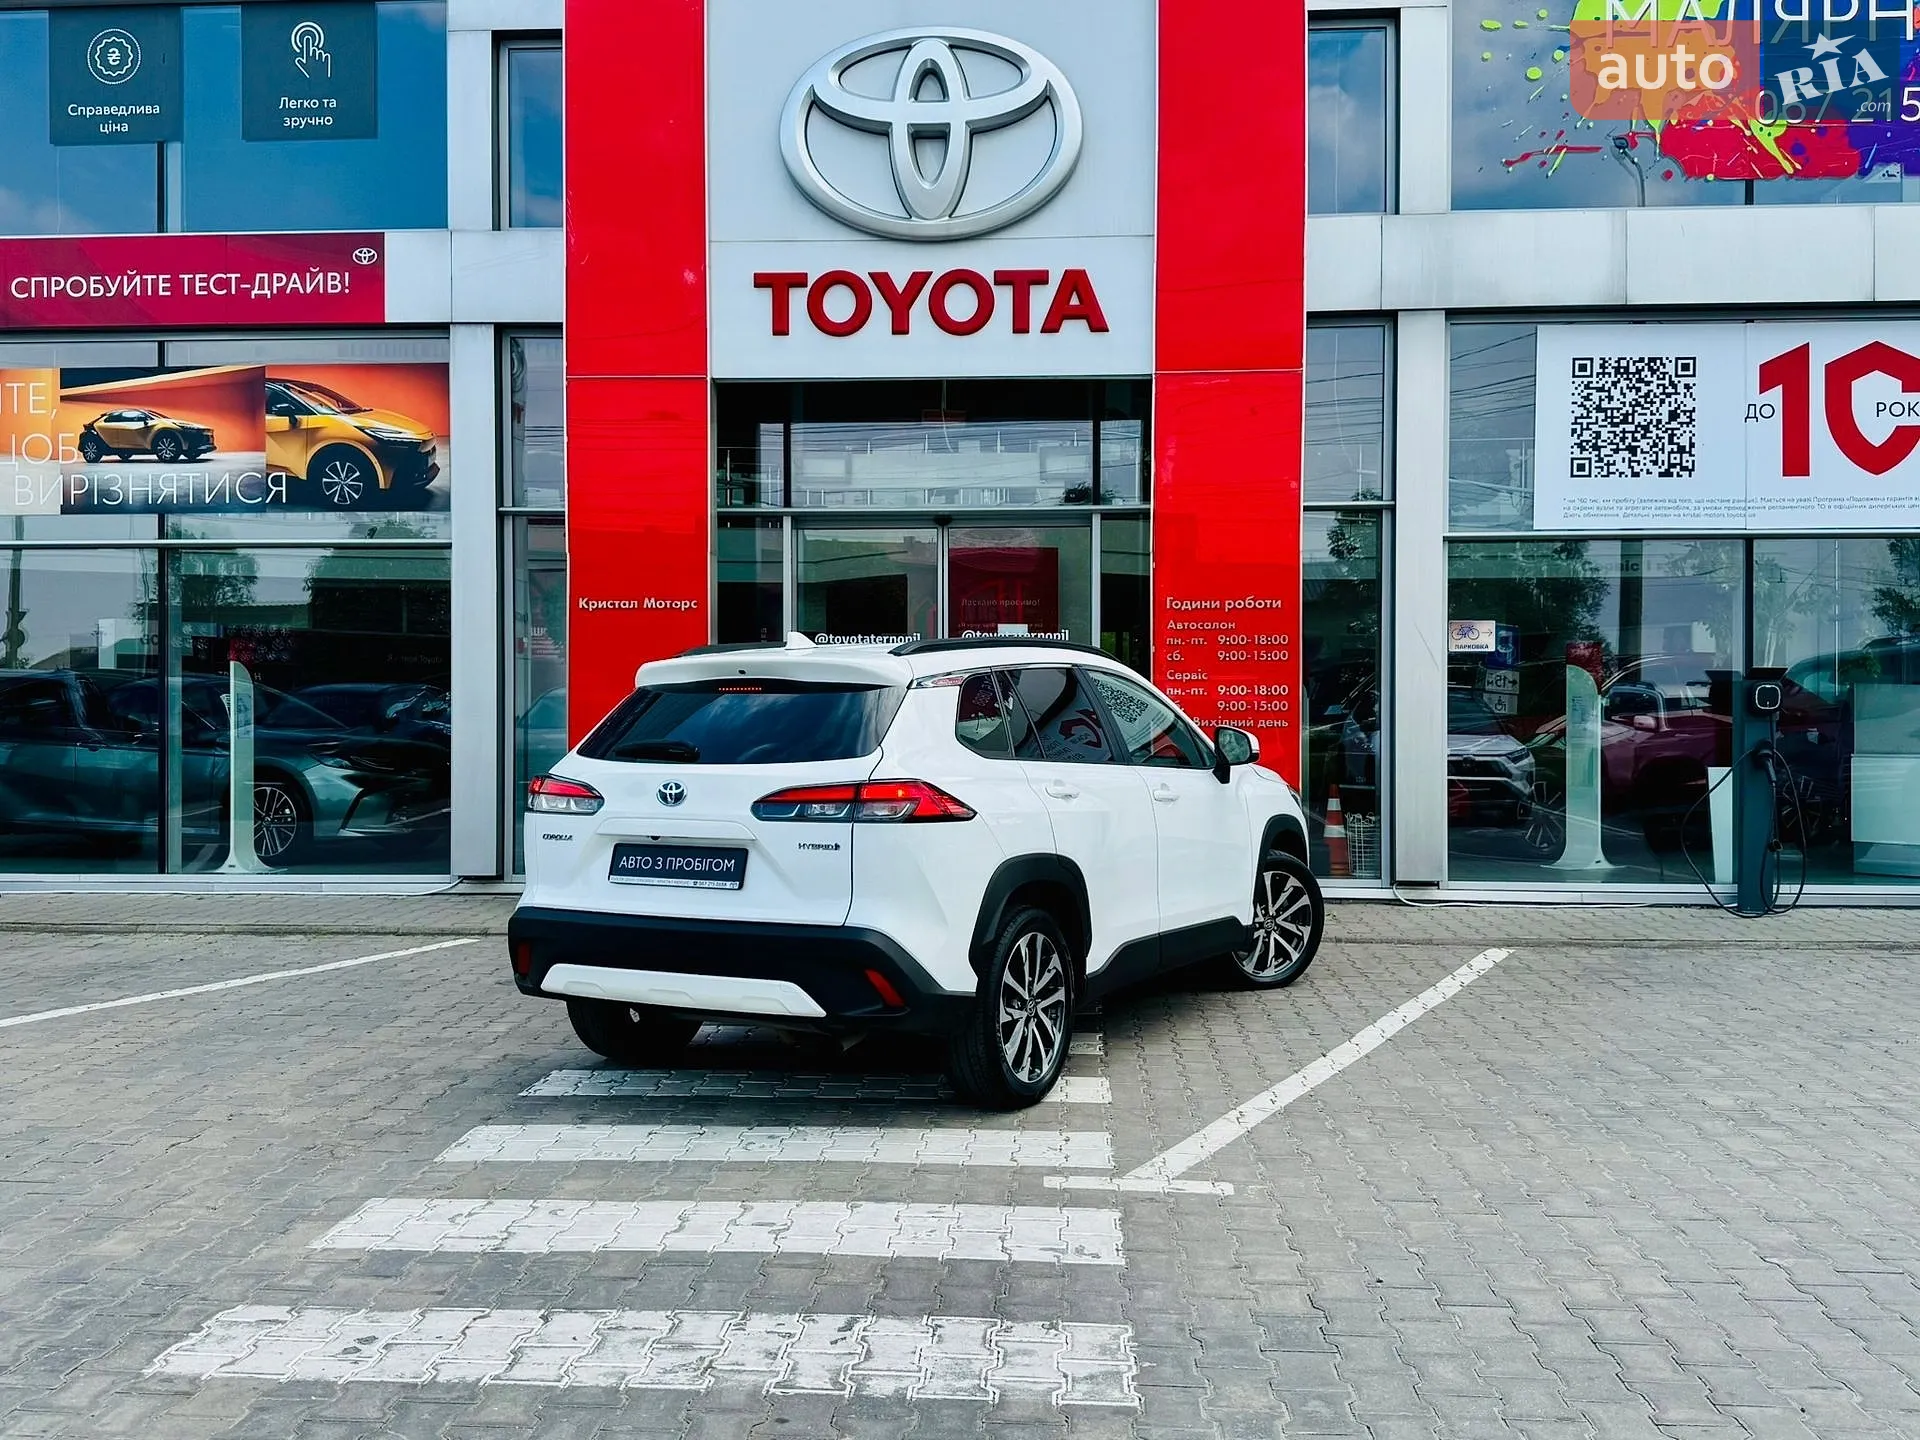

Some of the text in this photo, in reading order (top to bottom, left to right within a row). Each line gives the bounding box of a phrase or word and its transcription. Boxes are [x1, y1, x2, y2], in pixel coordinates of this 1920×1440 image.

[279, 96, 338, 111] Легко та
[68, 103, 160, 119] Справедлива
[99, 120, 129, 134] ціна
[283, 114, 334, 128] зручно
[10, 267, 350, 299] СПРОБУЙТЕ ТЕСТ-ДРАЙВ!
[753, 268, 1110, 338] TOYOTA
[0, 382, 57, 420] ТЕ,
[1744, 402, 1776, 423] ДО
[1876, 401, 1920, 418] РОК
[14, 471, 287, 506] ВИРІЗНЯТИСЯ
[578, 597, 697, 611] Кристал Моторс
[1166, 595, 1282, 612] Години роботи
[1167, 620, 1236, 630] Автосалон
[1166, 634, 1289, 646] пн.-пт. 9:00-18:00
[1166, 650, 1289, 661] сб. 9:00-15:00
[1166, 668, 1209, 682] Сервіс
[1166, 685, 1289, 696] пн.-пт. 9:00-18:00
[1217, 701, 1289, 711] 9:00-15:00
[1257, 719, 1289, 729] день
[798, 842, 834, 850] HYBRID
[618, 856, 652, 869] АВТО
[666, 857, 735, 872] ПРОБІГОМ
